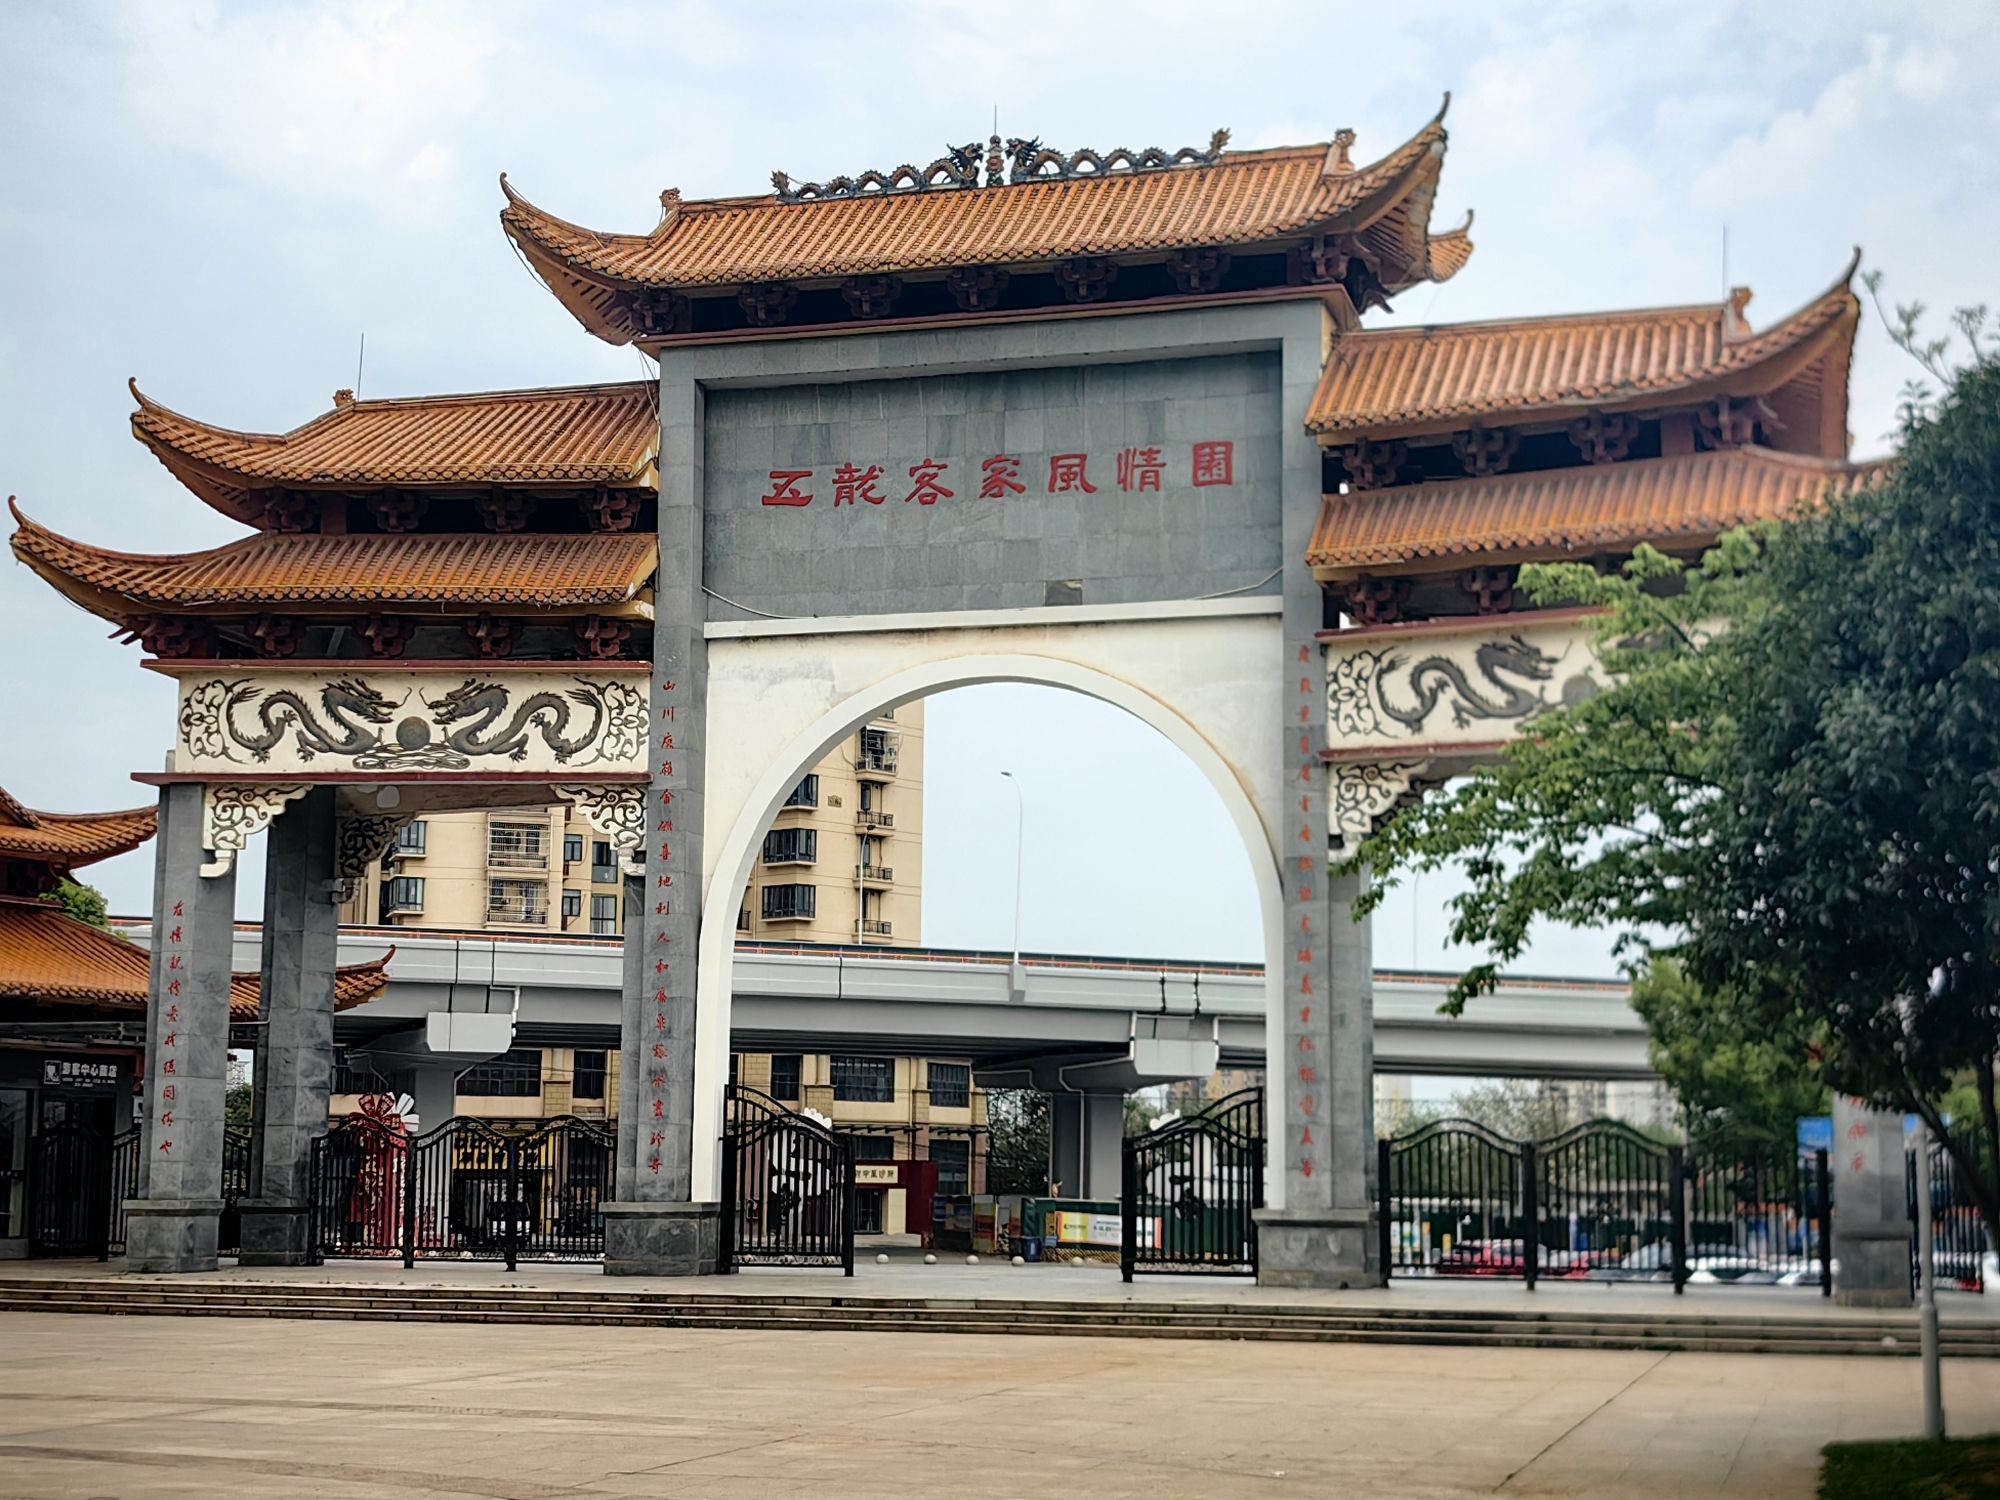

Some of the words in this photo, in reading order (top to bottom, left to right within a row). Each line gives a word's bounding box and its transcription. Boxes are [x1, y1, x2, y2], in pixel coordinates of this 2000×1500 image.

[761, 441, 1234, 507] 五龍客家風情園
